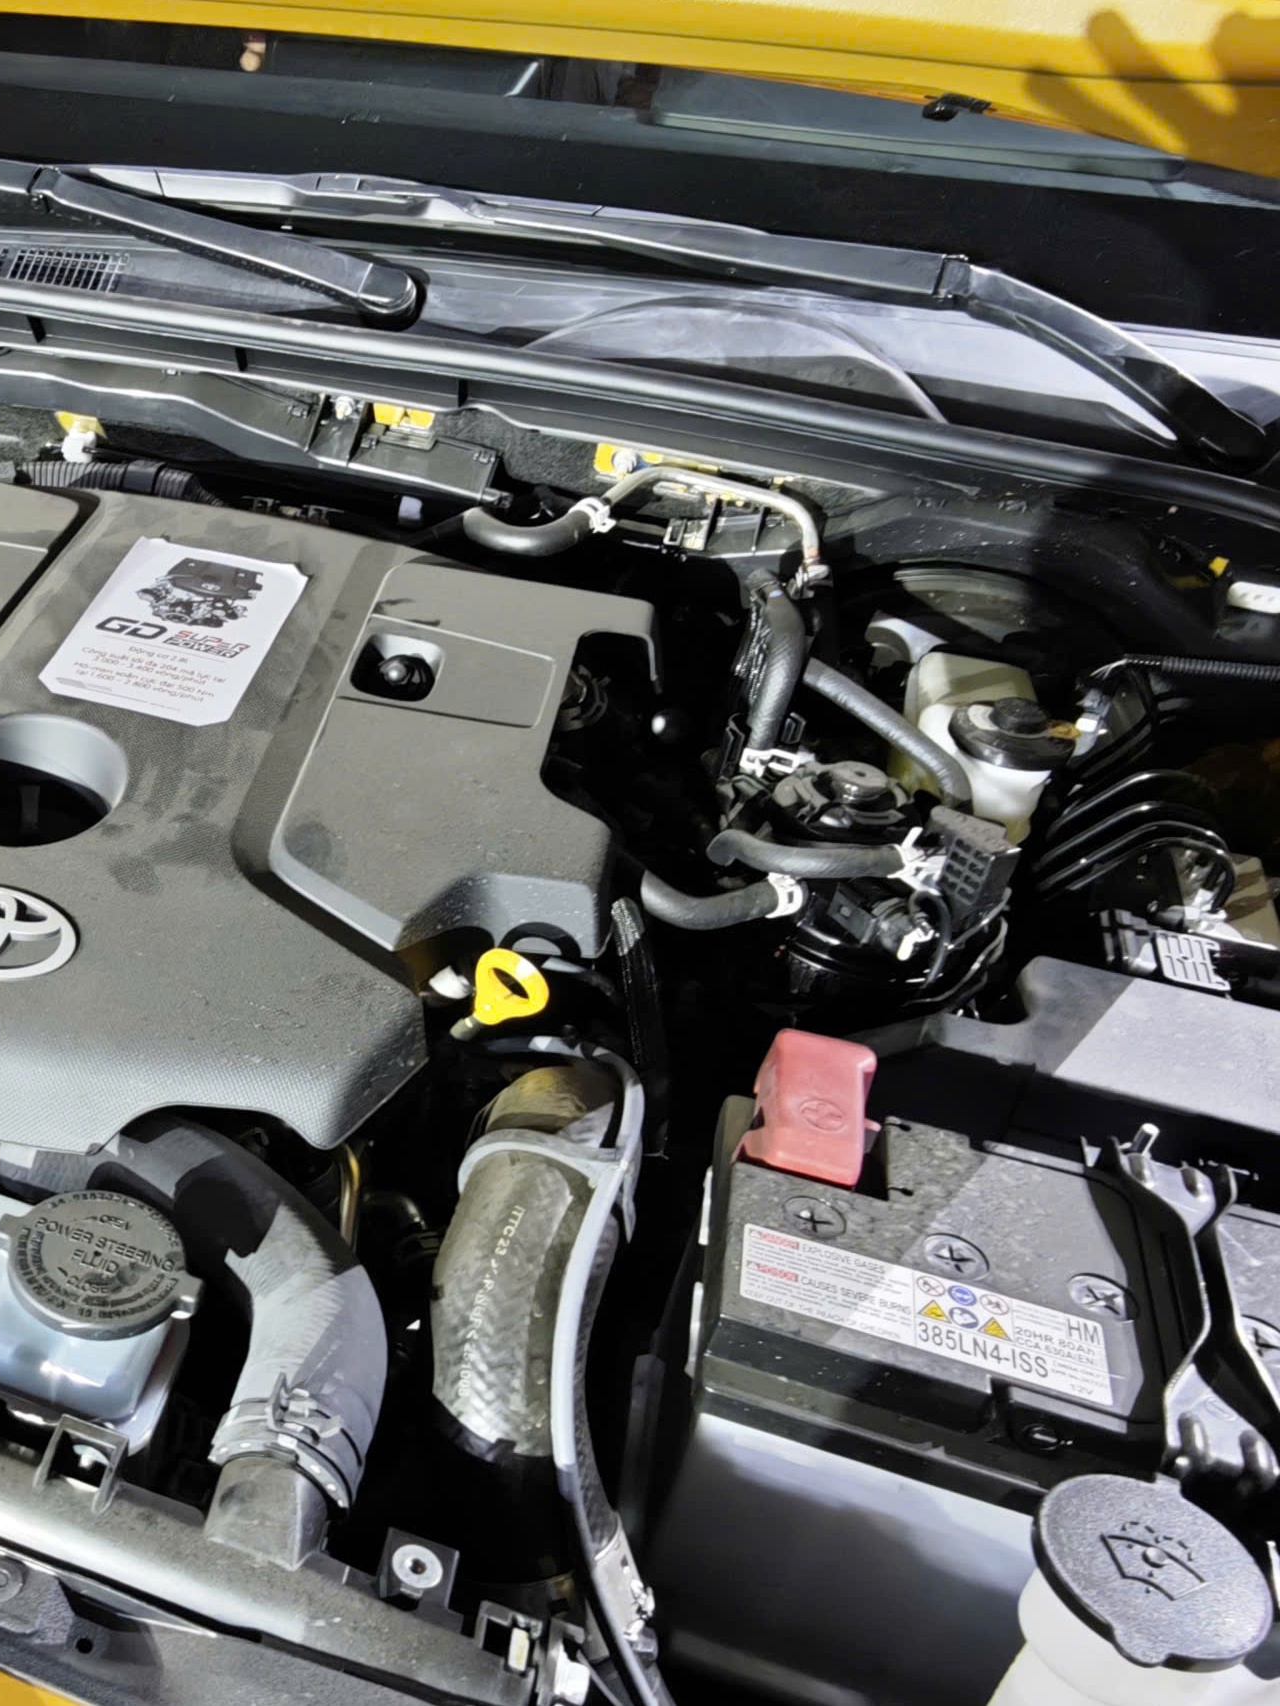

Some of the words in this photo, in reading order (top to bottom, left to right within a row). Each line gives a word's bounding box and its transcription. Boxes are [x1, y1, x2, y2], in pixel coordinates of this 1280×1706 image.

[95, 616, 167, 639] GD
[163, 637, 240, 658] POWER
[177, 630, 250, 652] SUPER
[35, 1217, 94, 1244] POWER
[95, 1236, 176, 1273] STEERING
[72, 1248, 120, 1274] FLUID
[66, 1275, 110, 1294] CLOSE
[1014, 1326, 1054, 1345] 20HR
[1067, 1317, 1100, 1345] HM
[918, 1321, 1048, 1378] 385LN4-ISS
[1016, 1336, 1041, 1350] CCA
